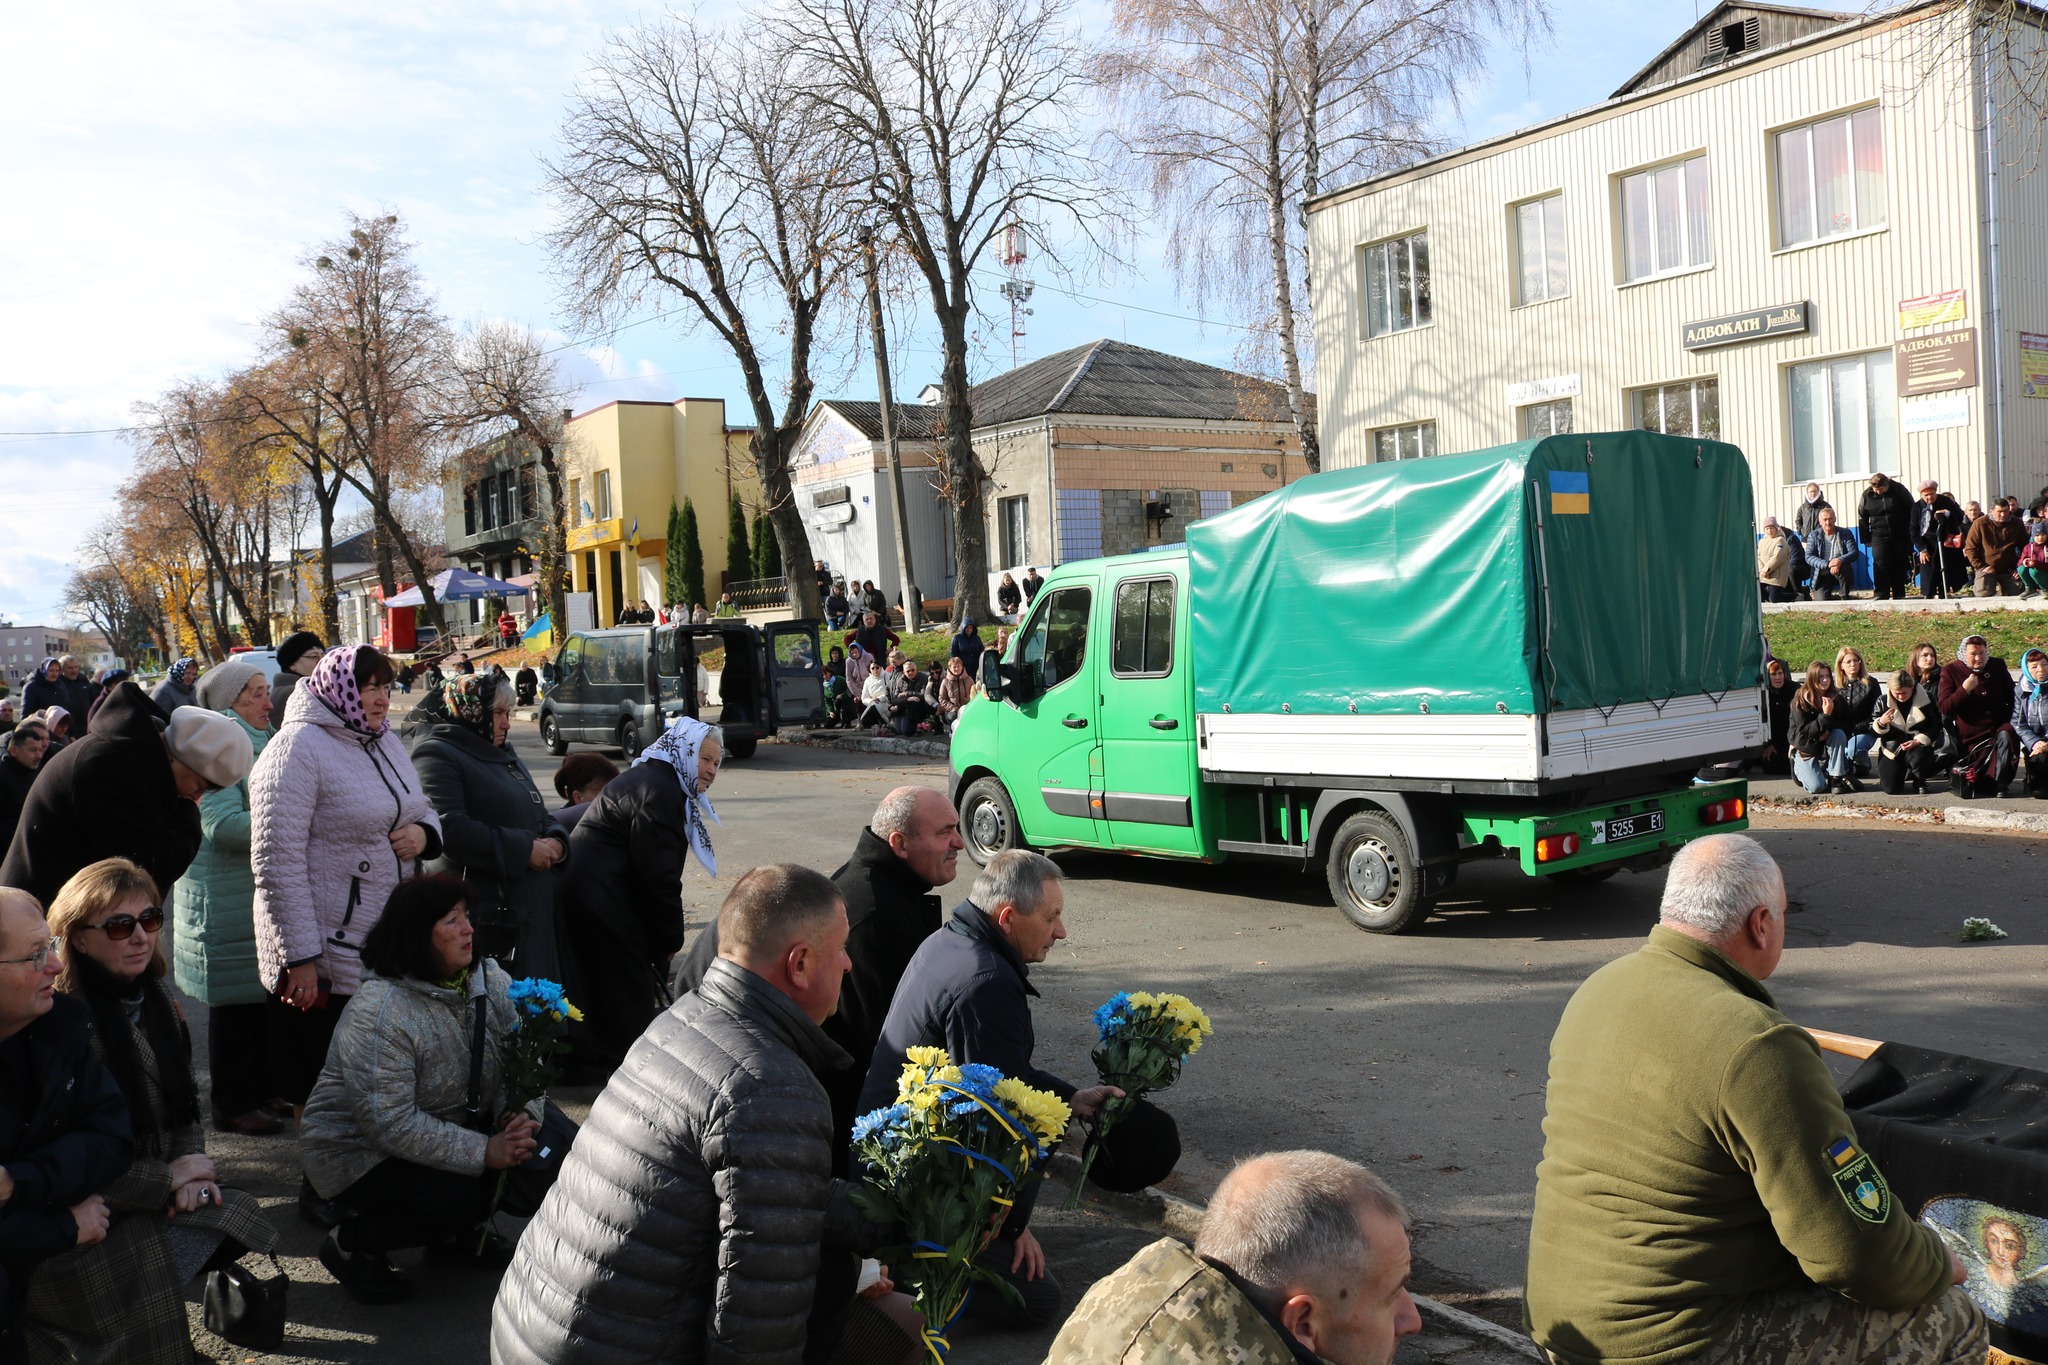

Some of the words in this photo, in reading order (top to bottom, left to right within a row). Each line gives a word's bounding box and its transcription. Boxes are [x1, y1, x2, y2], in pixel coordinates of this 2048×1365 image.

[1686, 317, 1760, 343] АДВОКАТИ
[1898, 332, 1970, 354] АДВОКАТИ
[1906, 411, 1966, 426] СТОМАТОЛОГІЯ
[1611, 819, 1634, 838] 5255
[1650, 813, 1662, 829] E1
